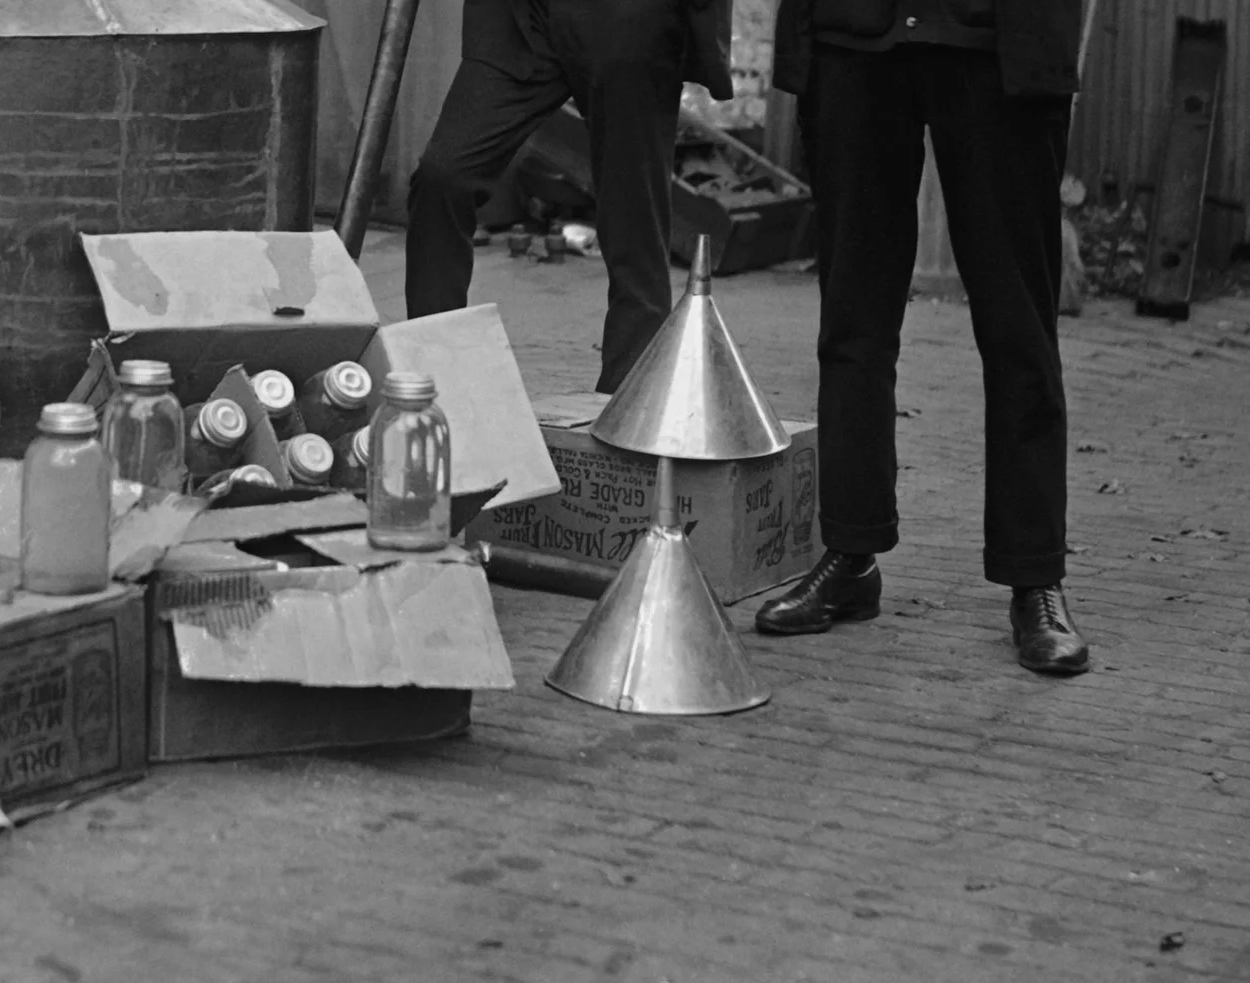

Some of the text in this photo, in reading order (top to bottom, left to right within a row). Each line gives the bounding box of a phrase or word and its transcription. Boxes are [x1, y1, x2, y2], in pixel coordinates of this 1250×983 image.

[590, 482, 645, 508] GRADE
[595, 502, 618, 514] WITH
[493, 505, 536, 526] JARS
[560, 499, 650, 524] ACKED COMPLETE
[500, 520, 542, 548] FRUIT
[543, 515, 605, 559] MASON
[1, 743, 62, 787] DREY
